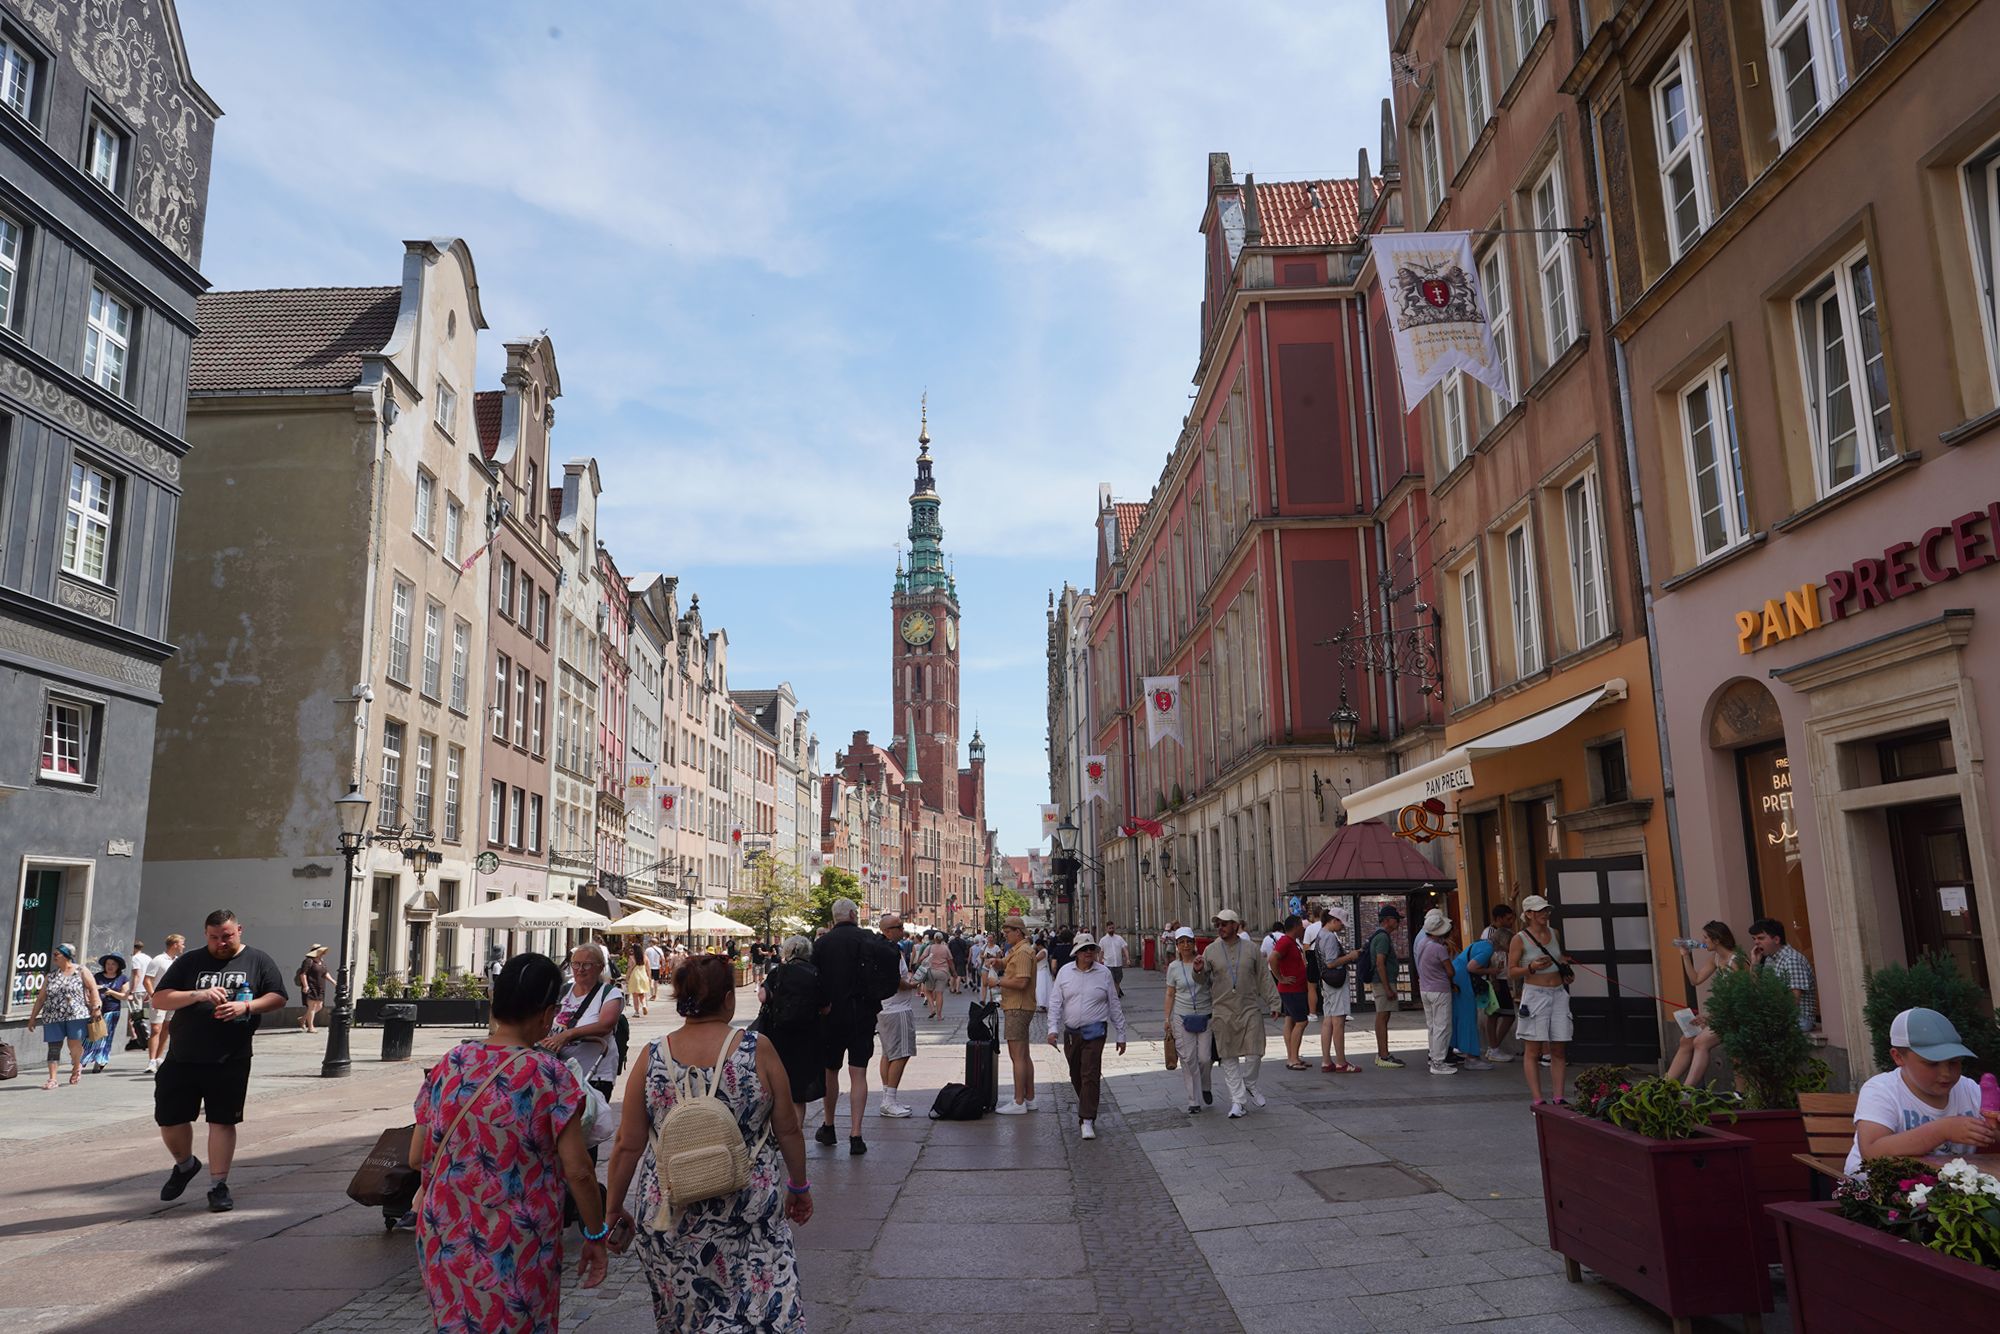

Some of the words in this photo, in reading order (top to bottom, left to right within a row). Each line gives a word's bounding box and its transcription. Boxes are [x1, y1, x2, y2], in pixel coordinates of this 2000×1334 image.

[1735, 583, 1822, 655] PAN
[1426, 777, 1441, 797] PAN
[1442, 769, 1469, 791] PRECEL
[1772, 774, 1792, 790] BA
[525, 920, 564, 928] STARBUCKS
